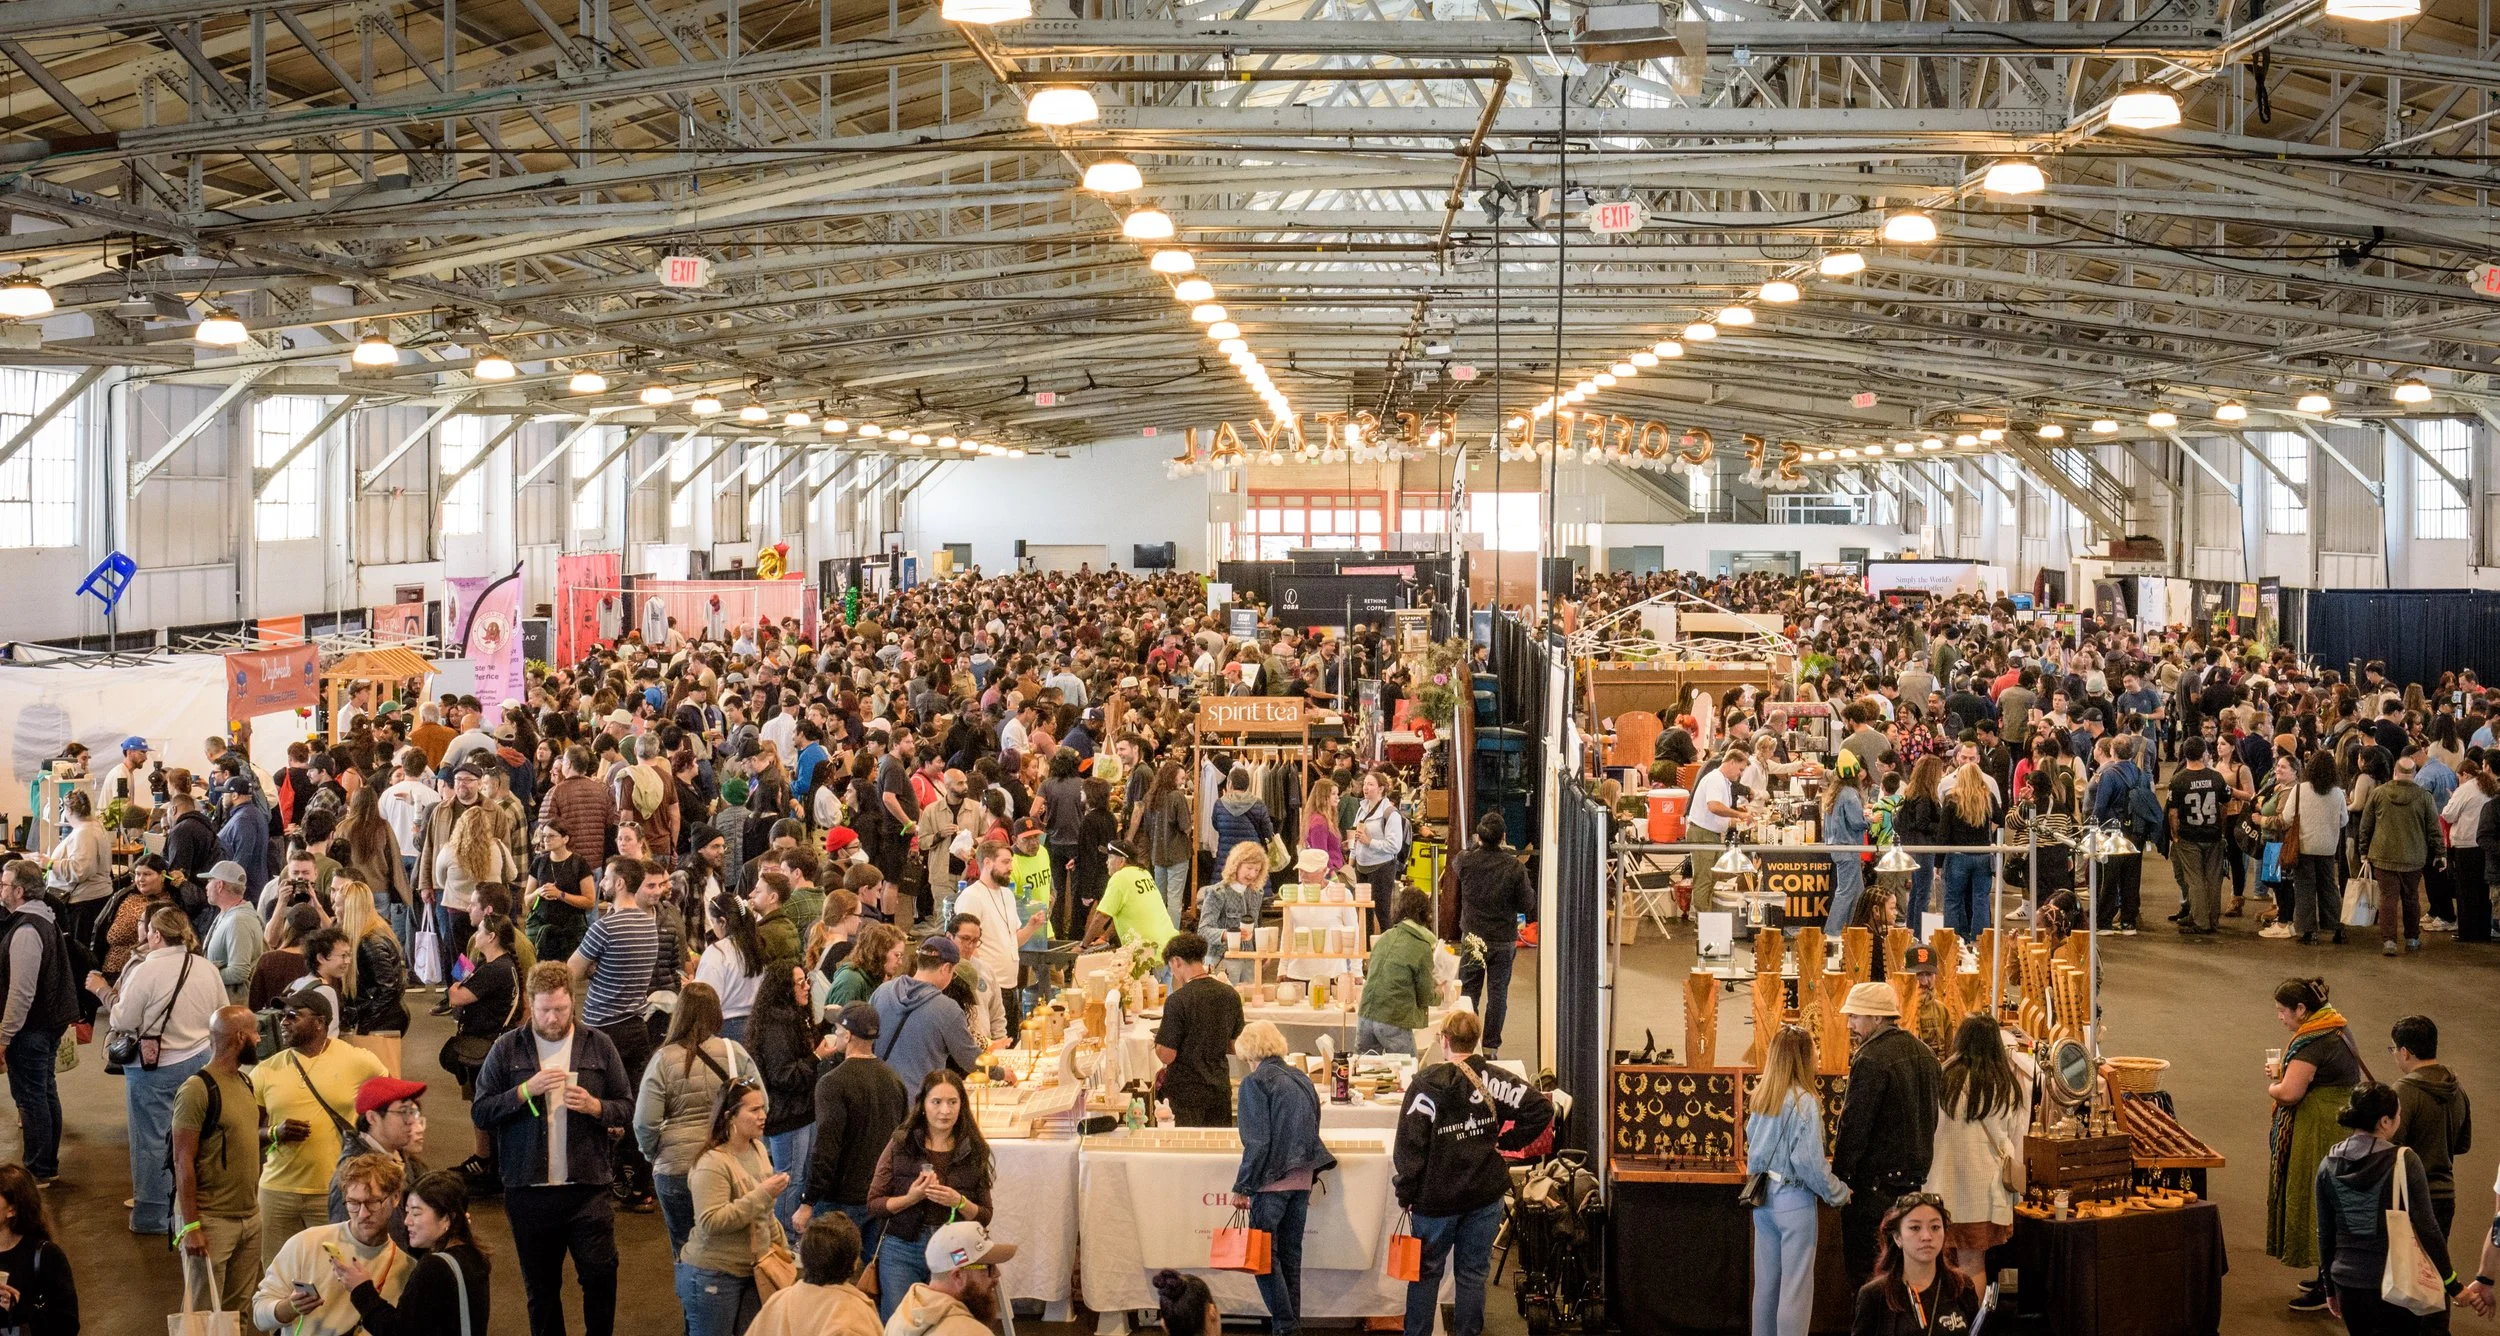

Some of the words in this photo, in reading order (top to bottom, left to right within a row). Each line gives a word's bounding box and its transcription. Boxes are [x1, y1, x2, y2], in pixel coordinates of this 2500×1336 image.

[1601, 205, 1630, 230] EXIT
[671, 260, 698, 283] EXIT
[1896, 576, 1916, 585] Simply
[1918, 576, 1928, 584] the
[1930, 576, 1952, 584] World's
[1208, 702, 1260, 727] spirit
[1266, 703, 1298, 721] tea
[2190, 779, 2213, 790] JACKSON
[2184, 791, 2218, 826] 34
[1767, 862, 1808, 871] WORLD'S
[1809, 863, 1832, 871] FIRST
[1135, 878, 1157, 895] STA
[1768, 874, 1830, 892] CORN
